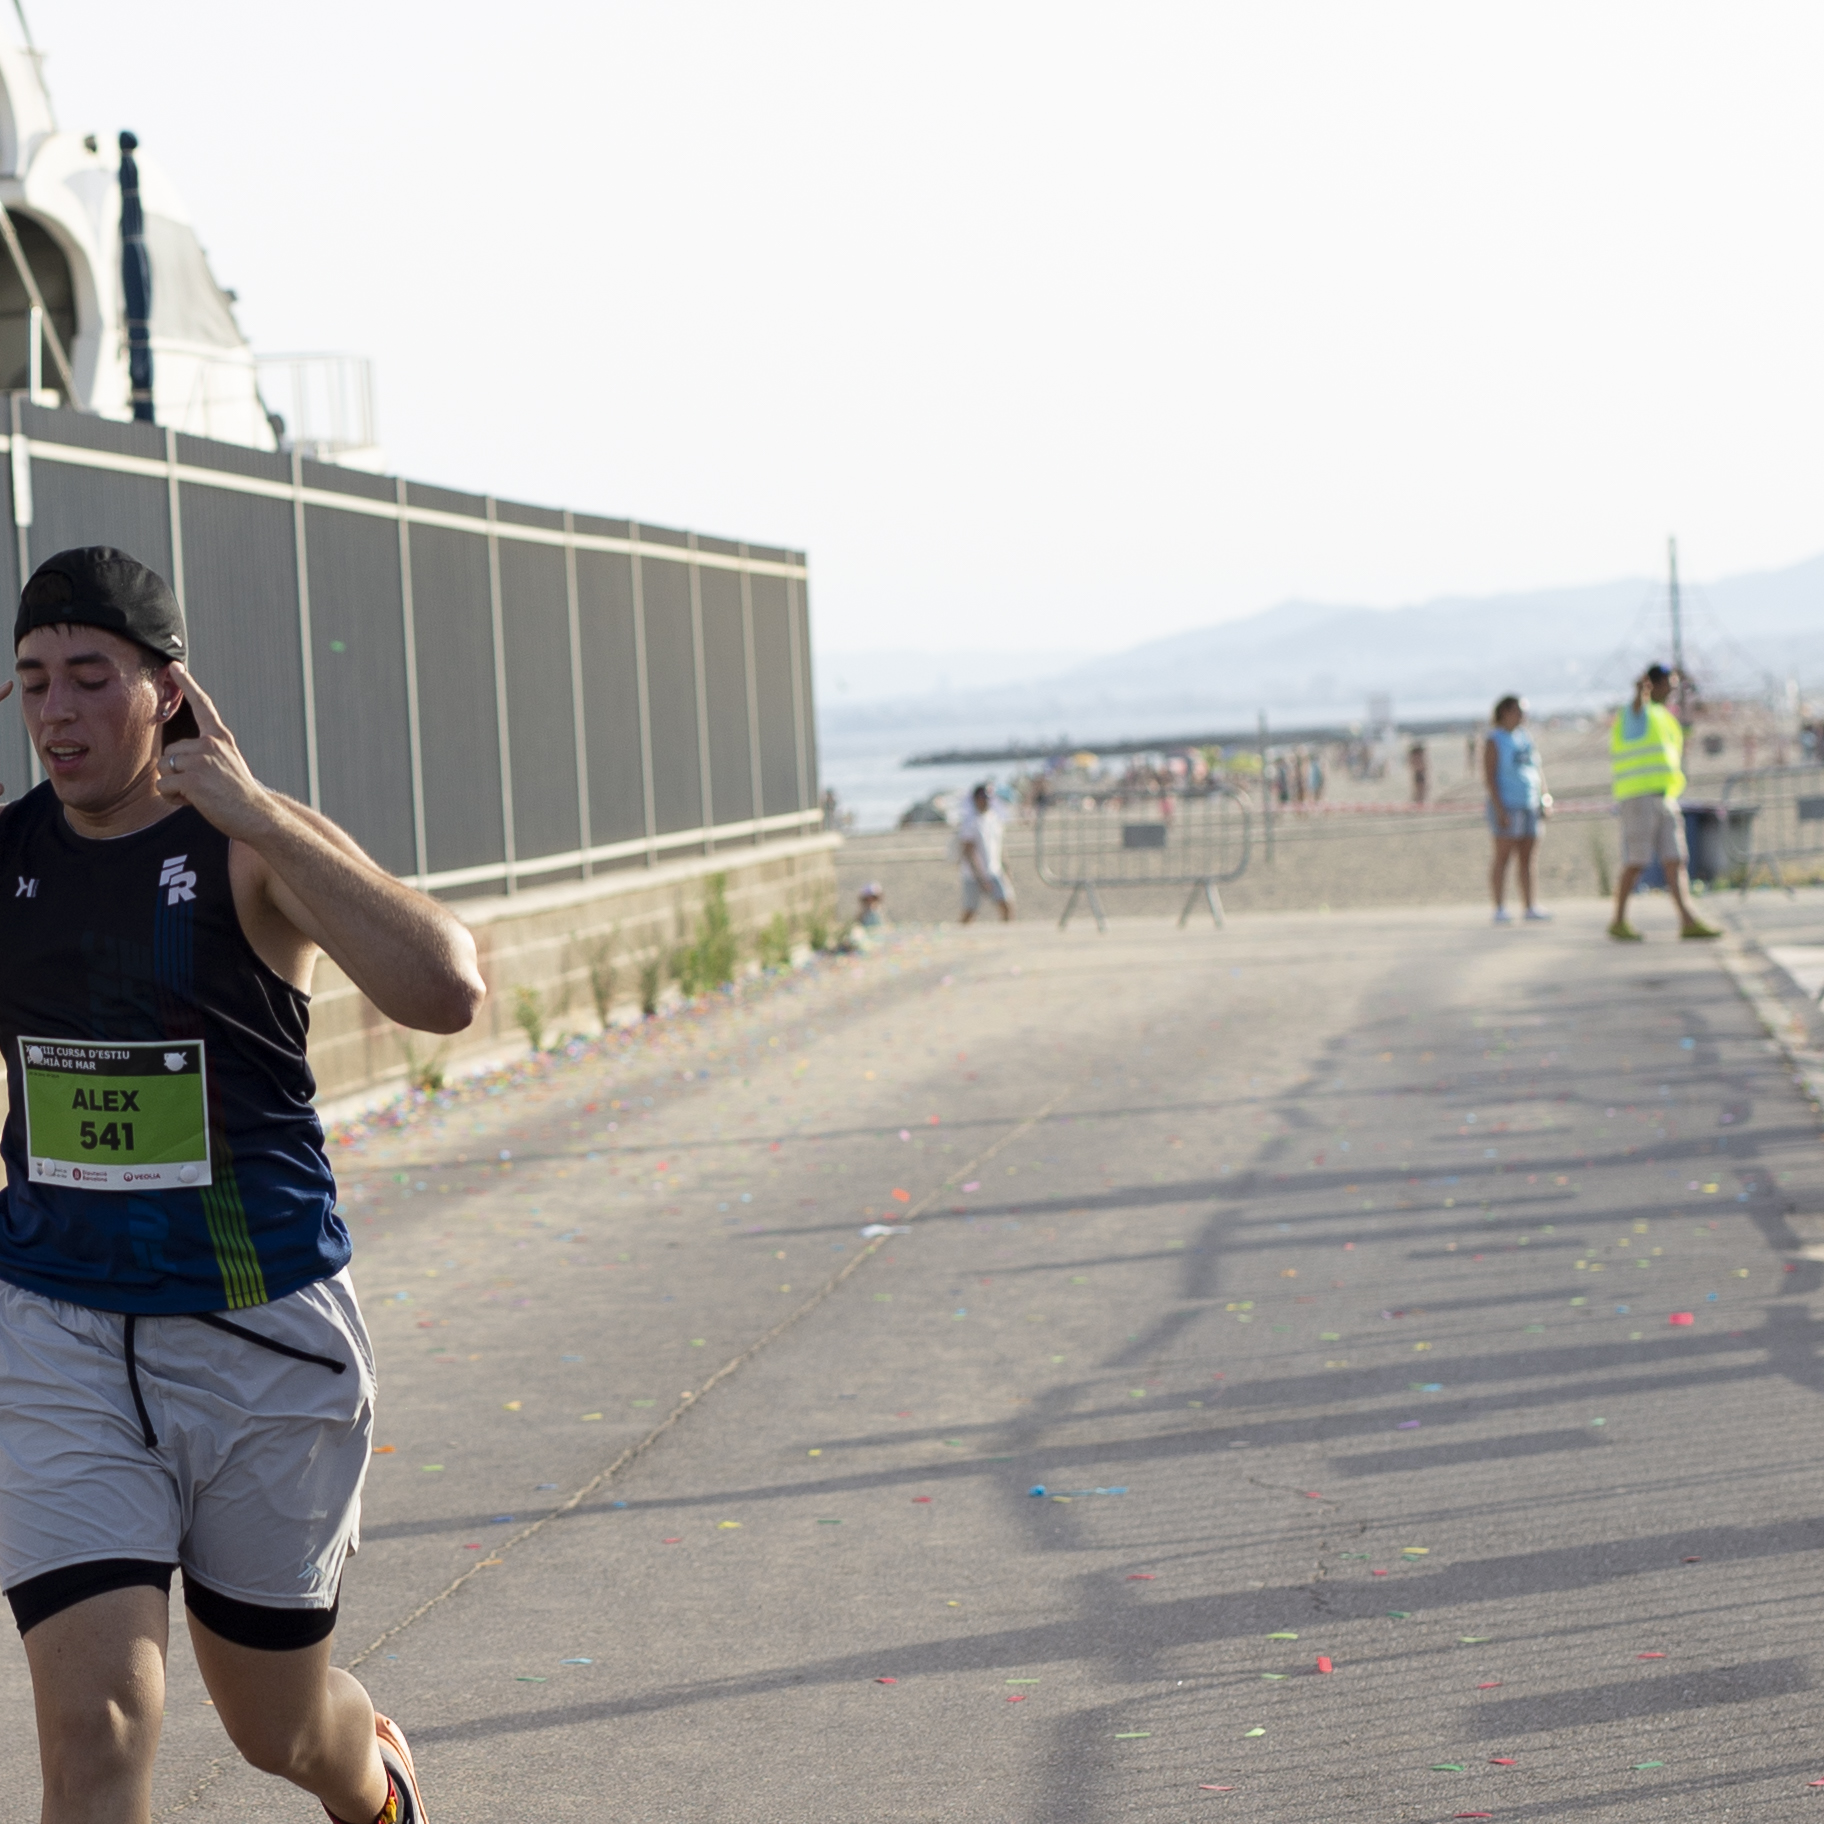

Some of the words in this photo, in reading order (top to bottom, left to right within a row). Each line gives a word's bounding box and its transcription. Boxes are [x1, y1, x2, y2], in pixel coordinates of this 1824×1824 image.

[26, 1055, 61, 1068] PMIÀ
[61, 1059, 74, 1069] DE
[75, 1060, 97, 1071] MAR
[56, 1047, 87, 1058] CURSA
[88, 1049, 131, 1060] D'ESTIU
[71, 1088, 141, 1112] ALEX
[79, 1121, 135, 1151] 541
